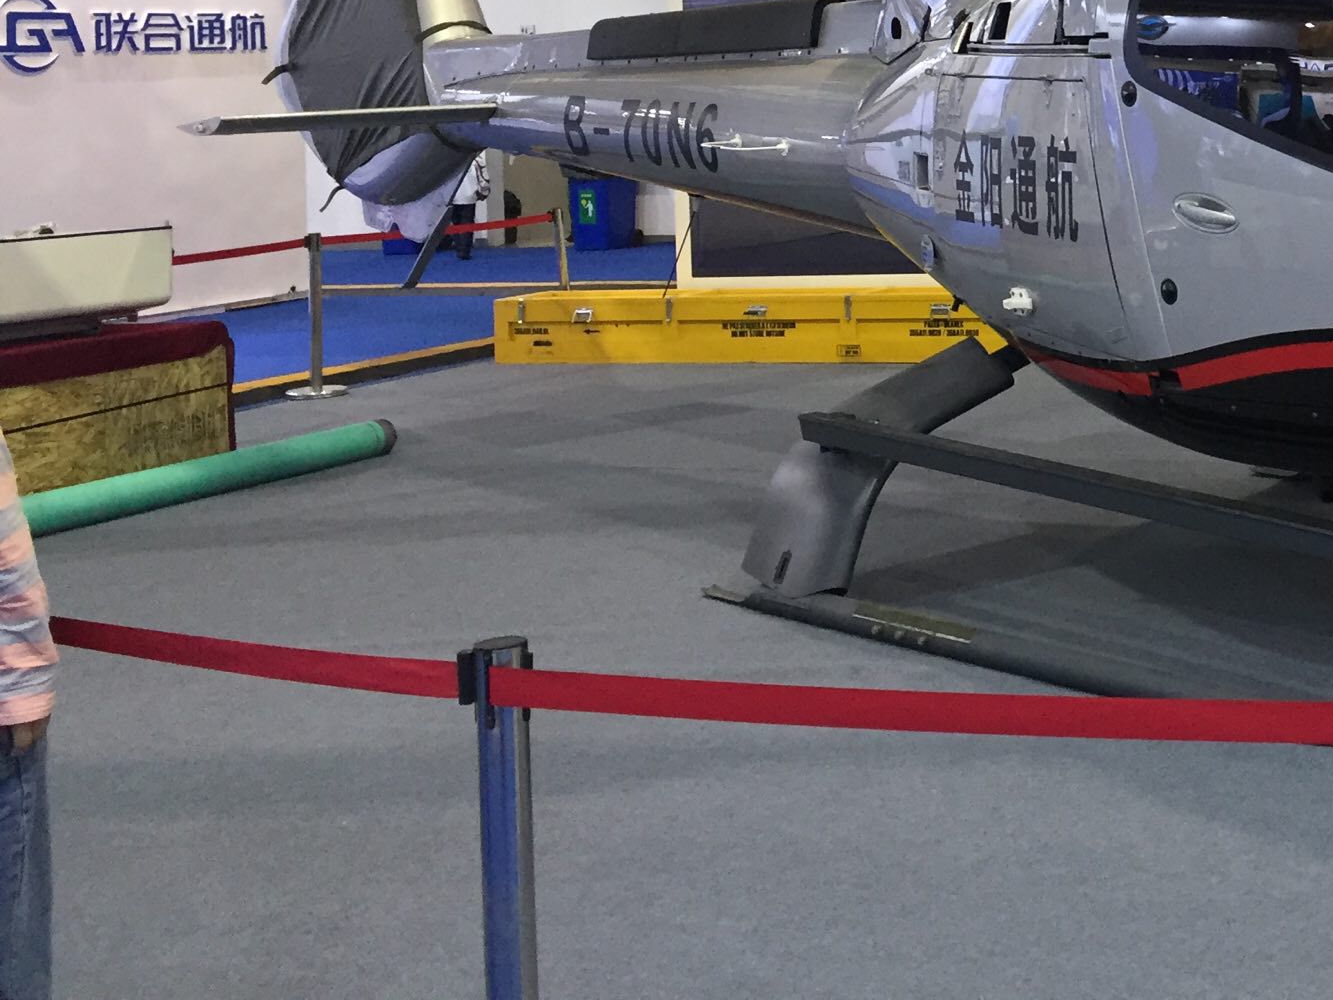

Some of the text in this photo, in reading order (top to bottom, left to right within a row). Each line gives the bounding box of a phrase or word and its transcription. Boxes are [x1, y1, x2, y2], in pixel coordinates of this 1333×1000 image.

[92, 12, 268, 53] 联合通航
[953, 128, 1079, 242] 金阳通航
